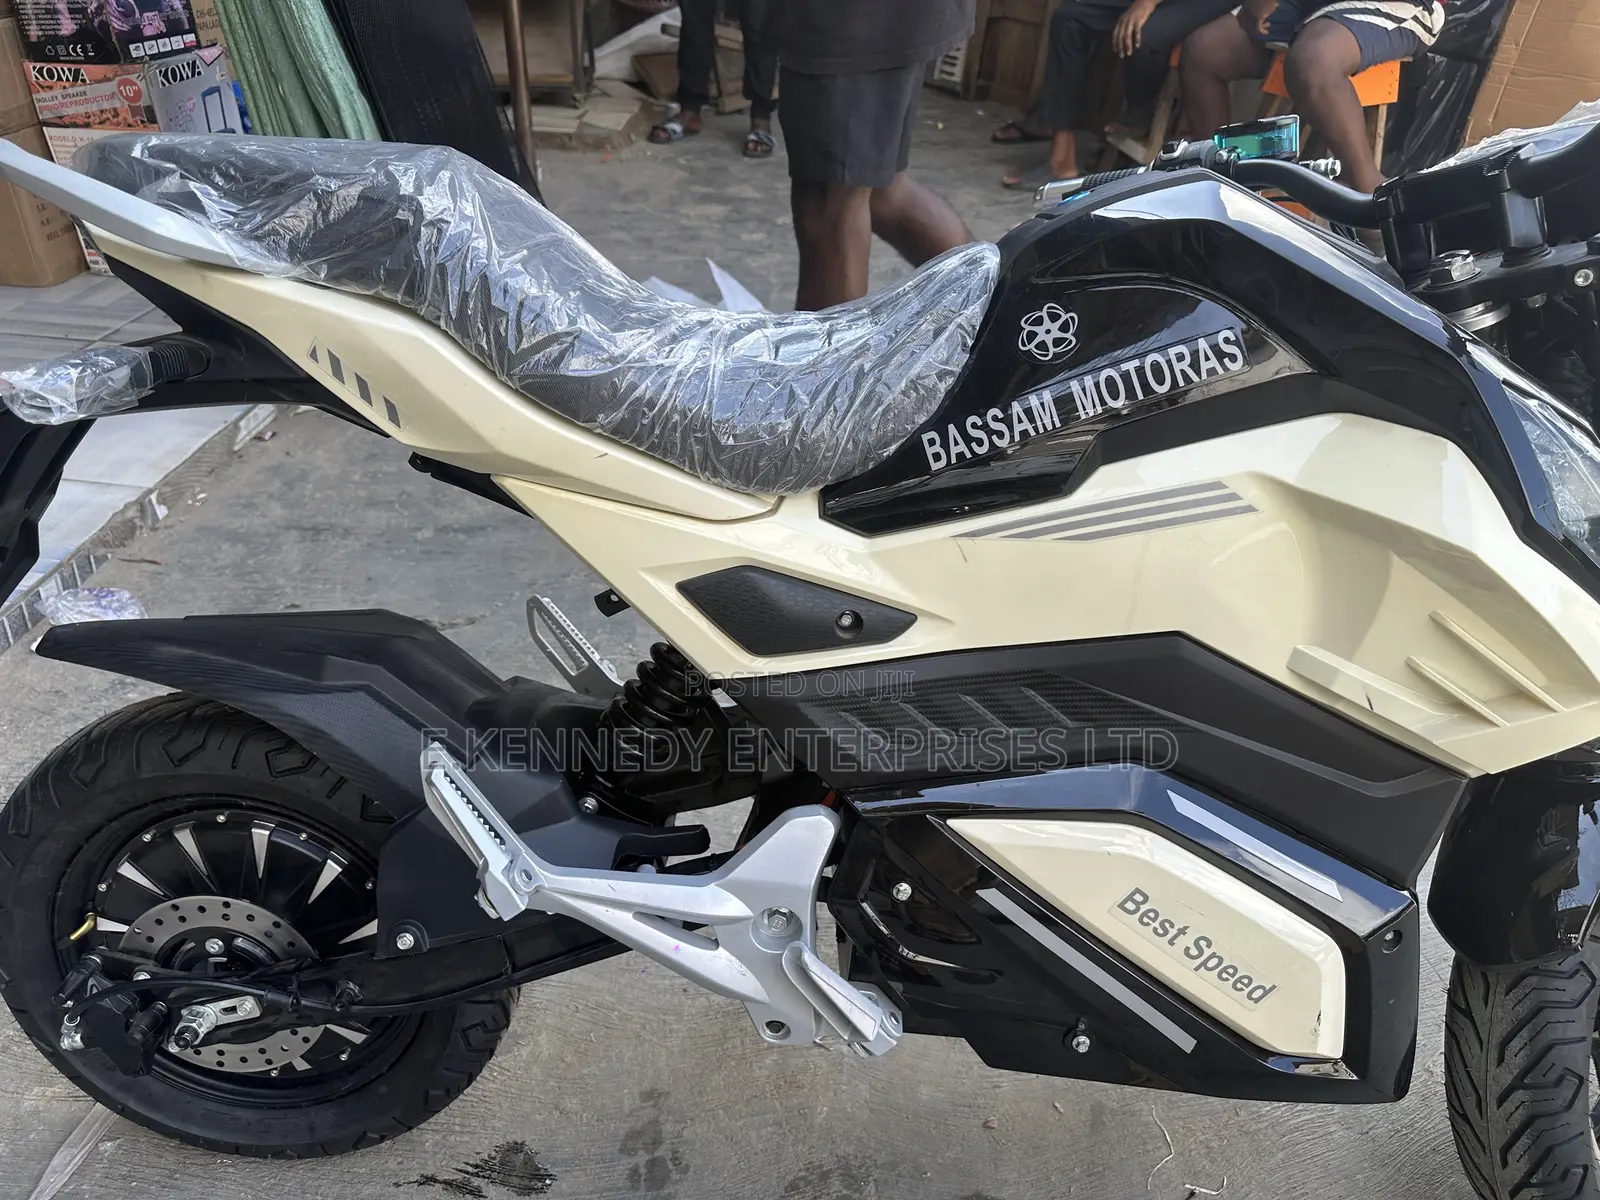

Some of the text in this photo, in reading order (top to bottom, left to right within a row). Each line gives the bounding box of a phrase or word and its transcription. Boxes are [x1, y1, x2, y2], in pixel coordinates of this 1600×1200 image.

[30, 65, 90, 84] KOWA
[156, 59, 204, 88] KOWA
[921, 329, 1245, 471] BASSAM MOTORAS
[1117, 886, 1278, 1004] Best Speed
